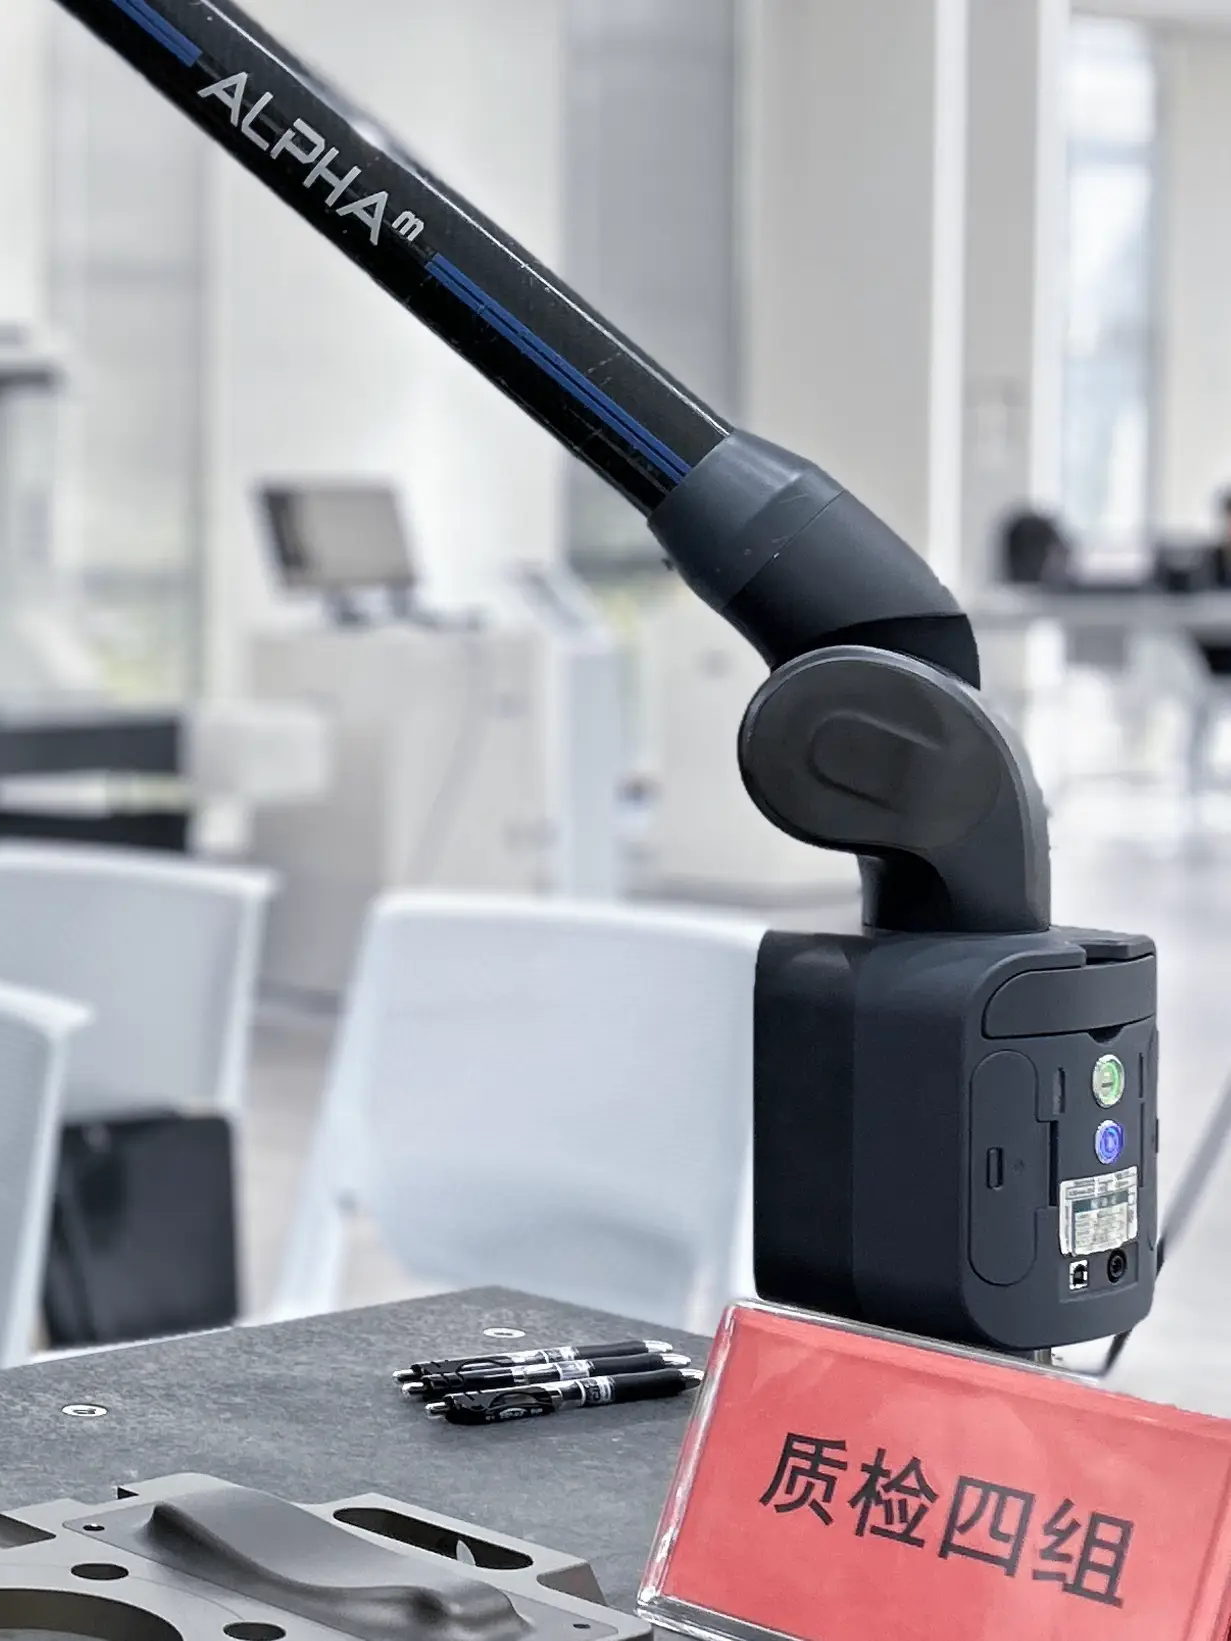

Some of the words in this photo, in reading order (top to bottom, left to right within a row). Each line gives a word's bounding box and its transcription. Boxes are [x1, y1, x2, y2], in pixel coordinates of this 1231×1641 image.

[197, 71, 388, 246] ALPHA
[759, 1432, 1135, 1608] 质检四组
